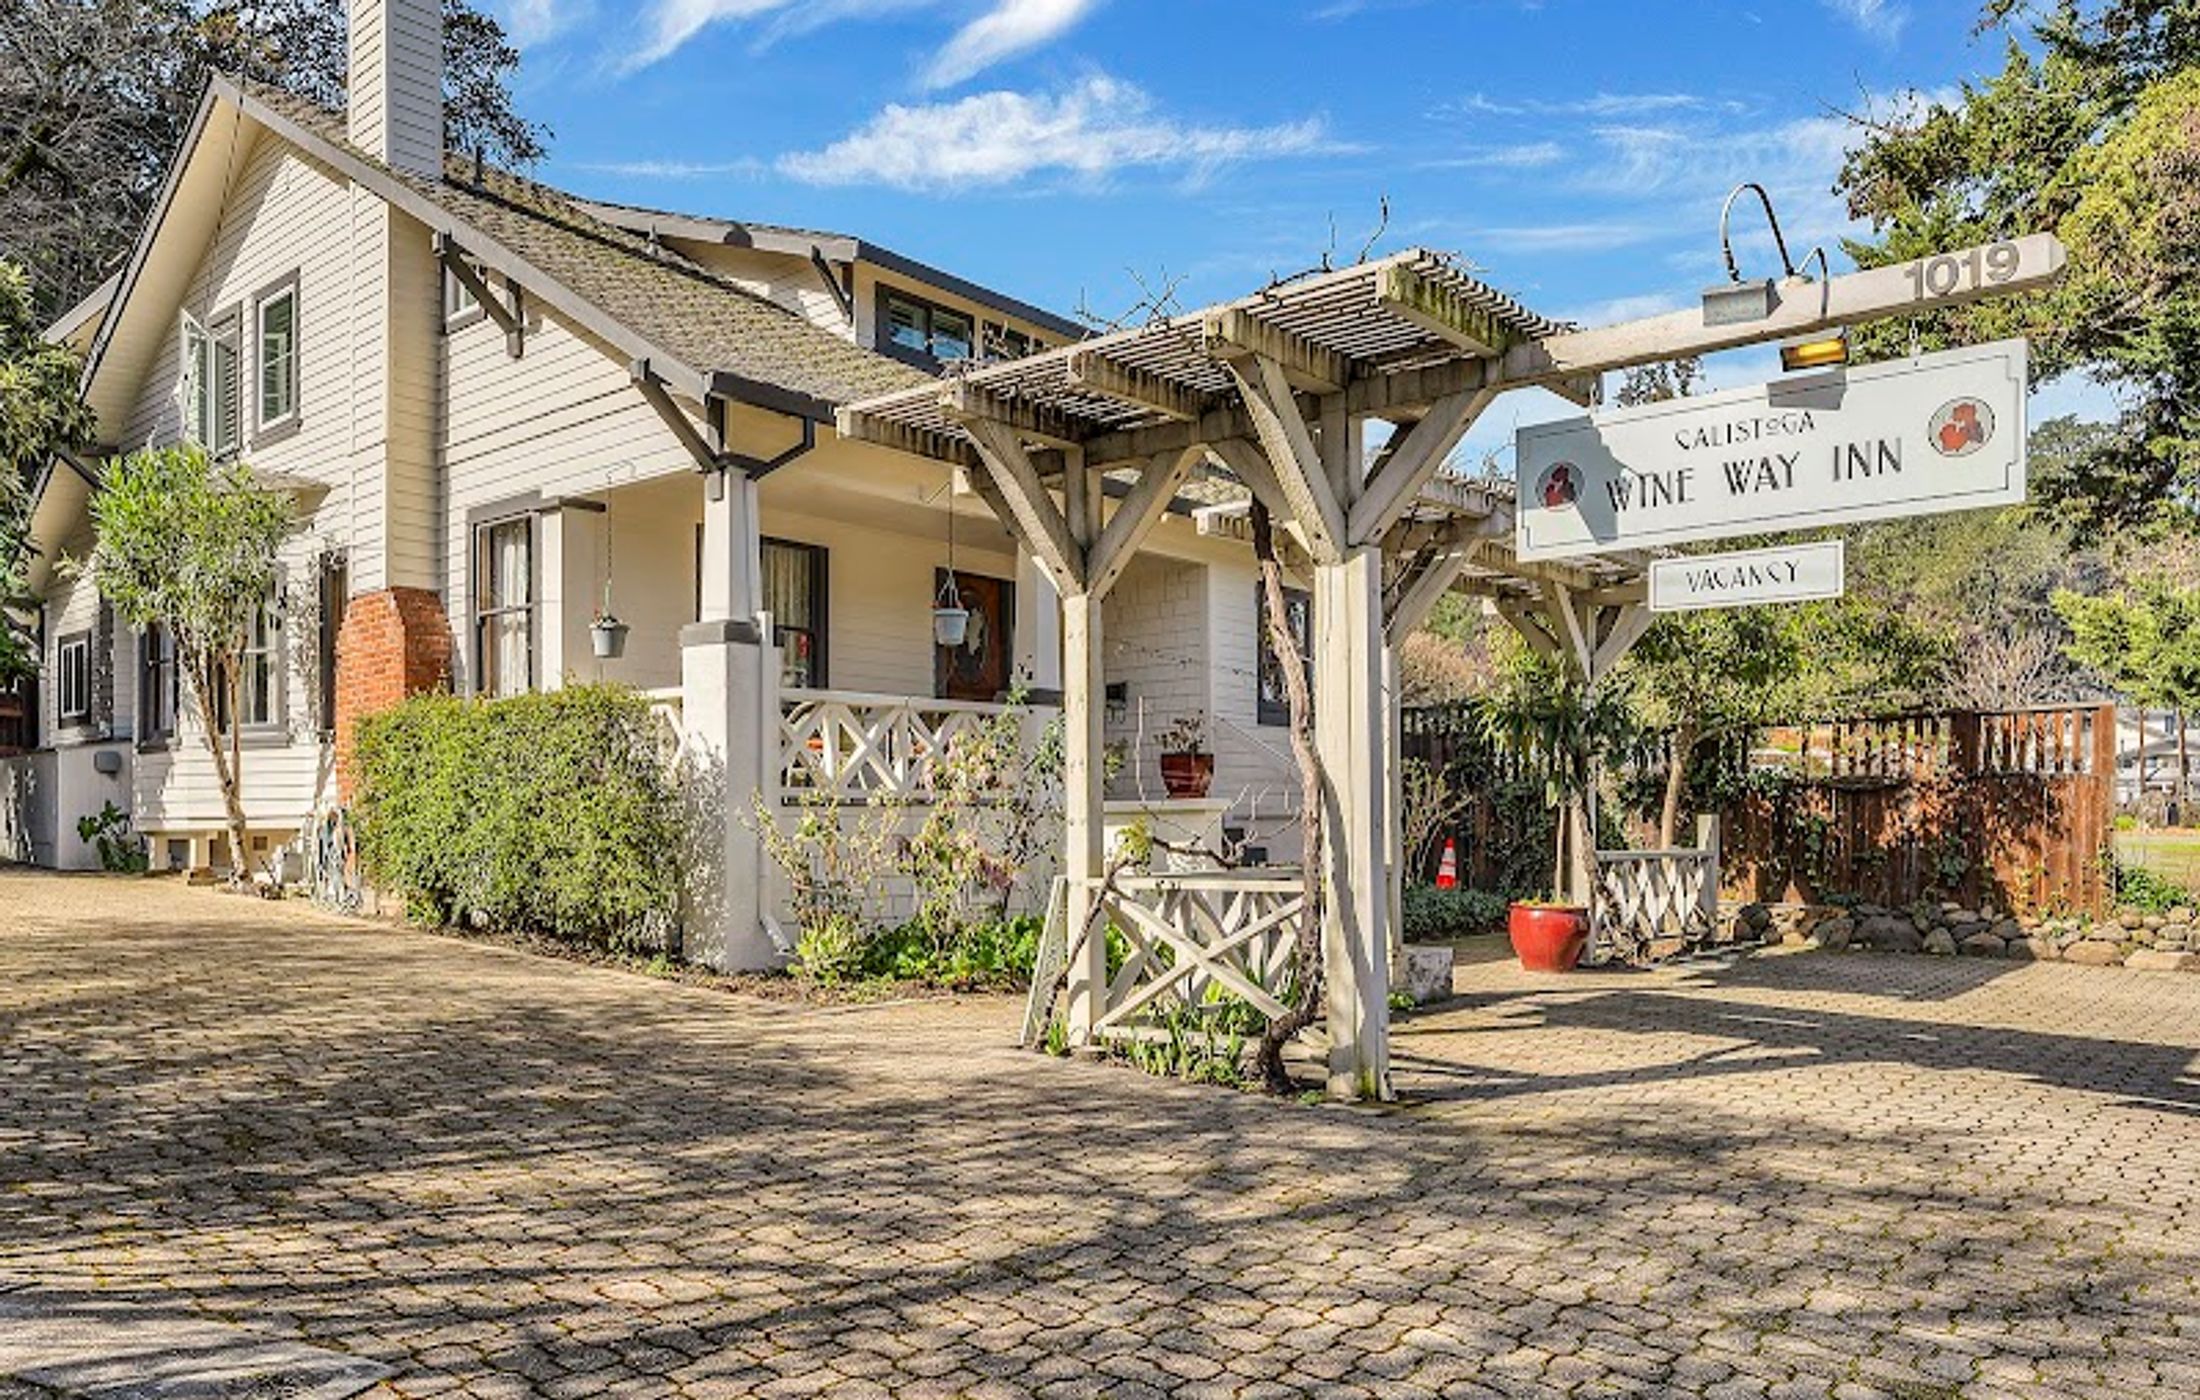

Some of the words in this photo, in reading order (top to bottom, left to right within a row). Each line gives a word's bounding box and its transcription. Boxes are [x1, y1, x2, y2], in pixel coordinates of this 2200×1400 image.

[1905, 243, 2019, 300] 1019
[1674, 410, 1816, 451] CALISTOGA
[1606, 467, 1695, 513] WINE
[1723, 451, 1801, 497] WAY
[1832, 436, 1903, 482] INN
[1685, 560, 1801, 594] VACANCY
